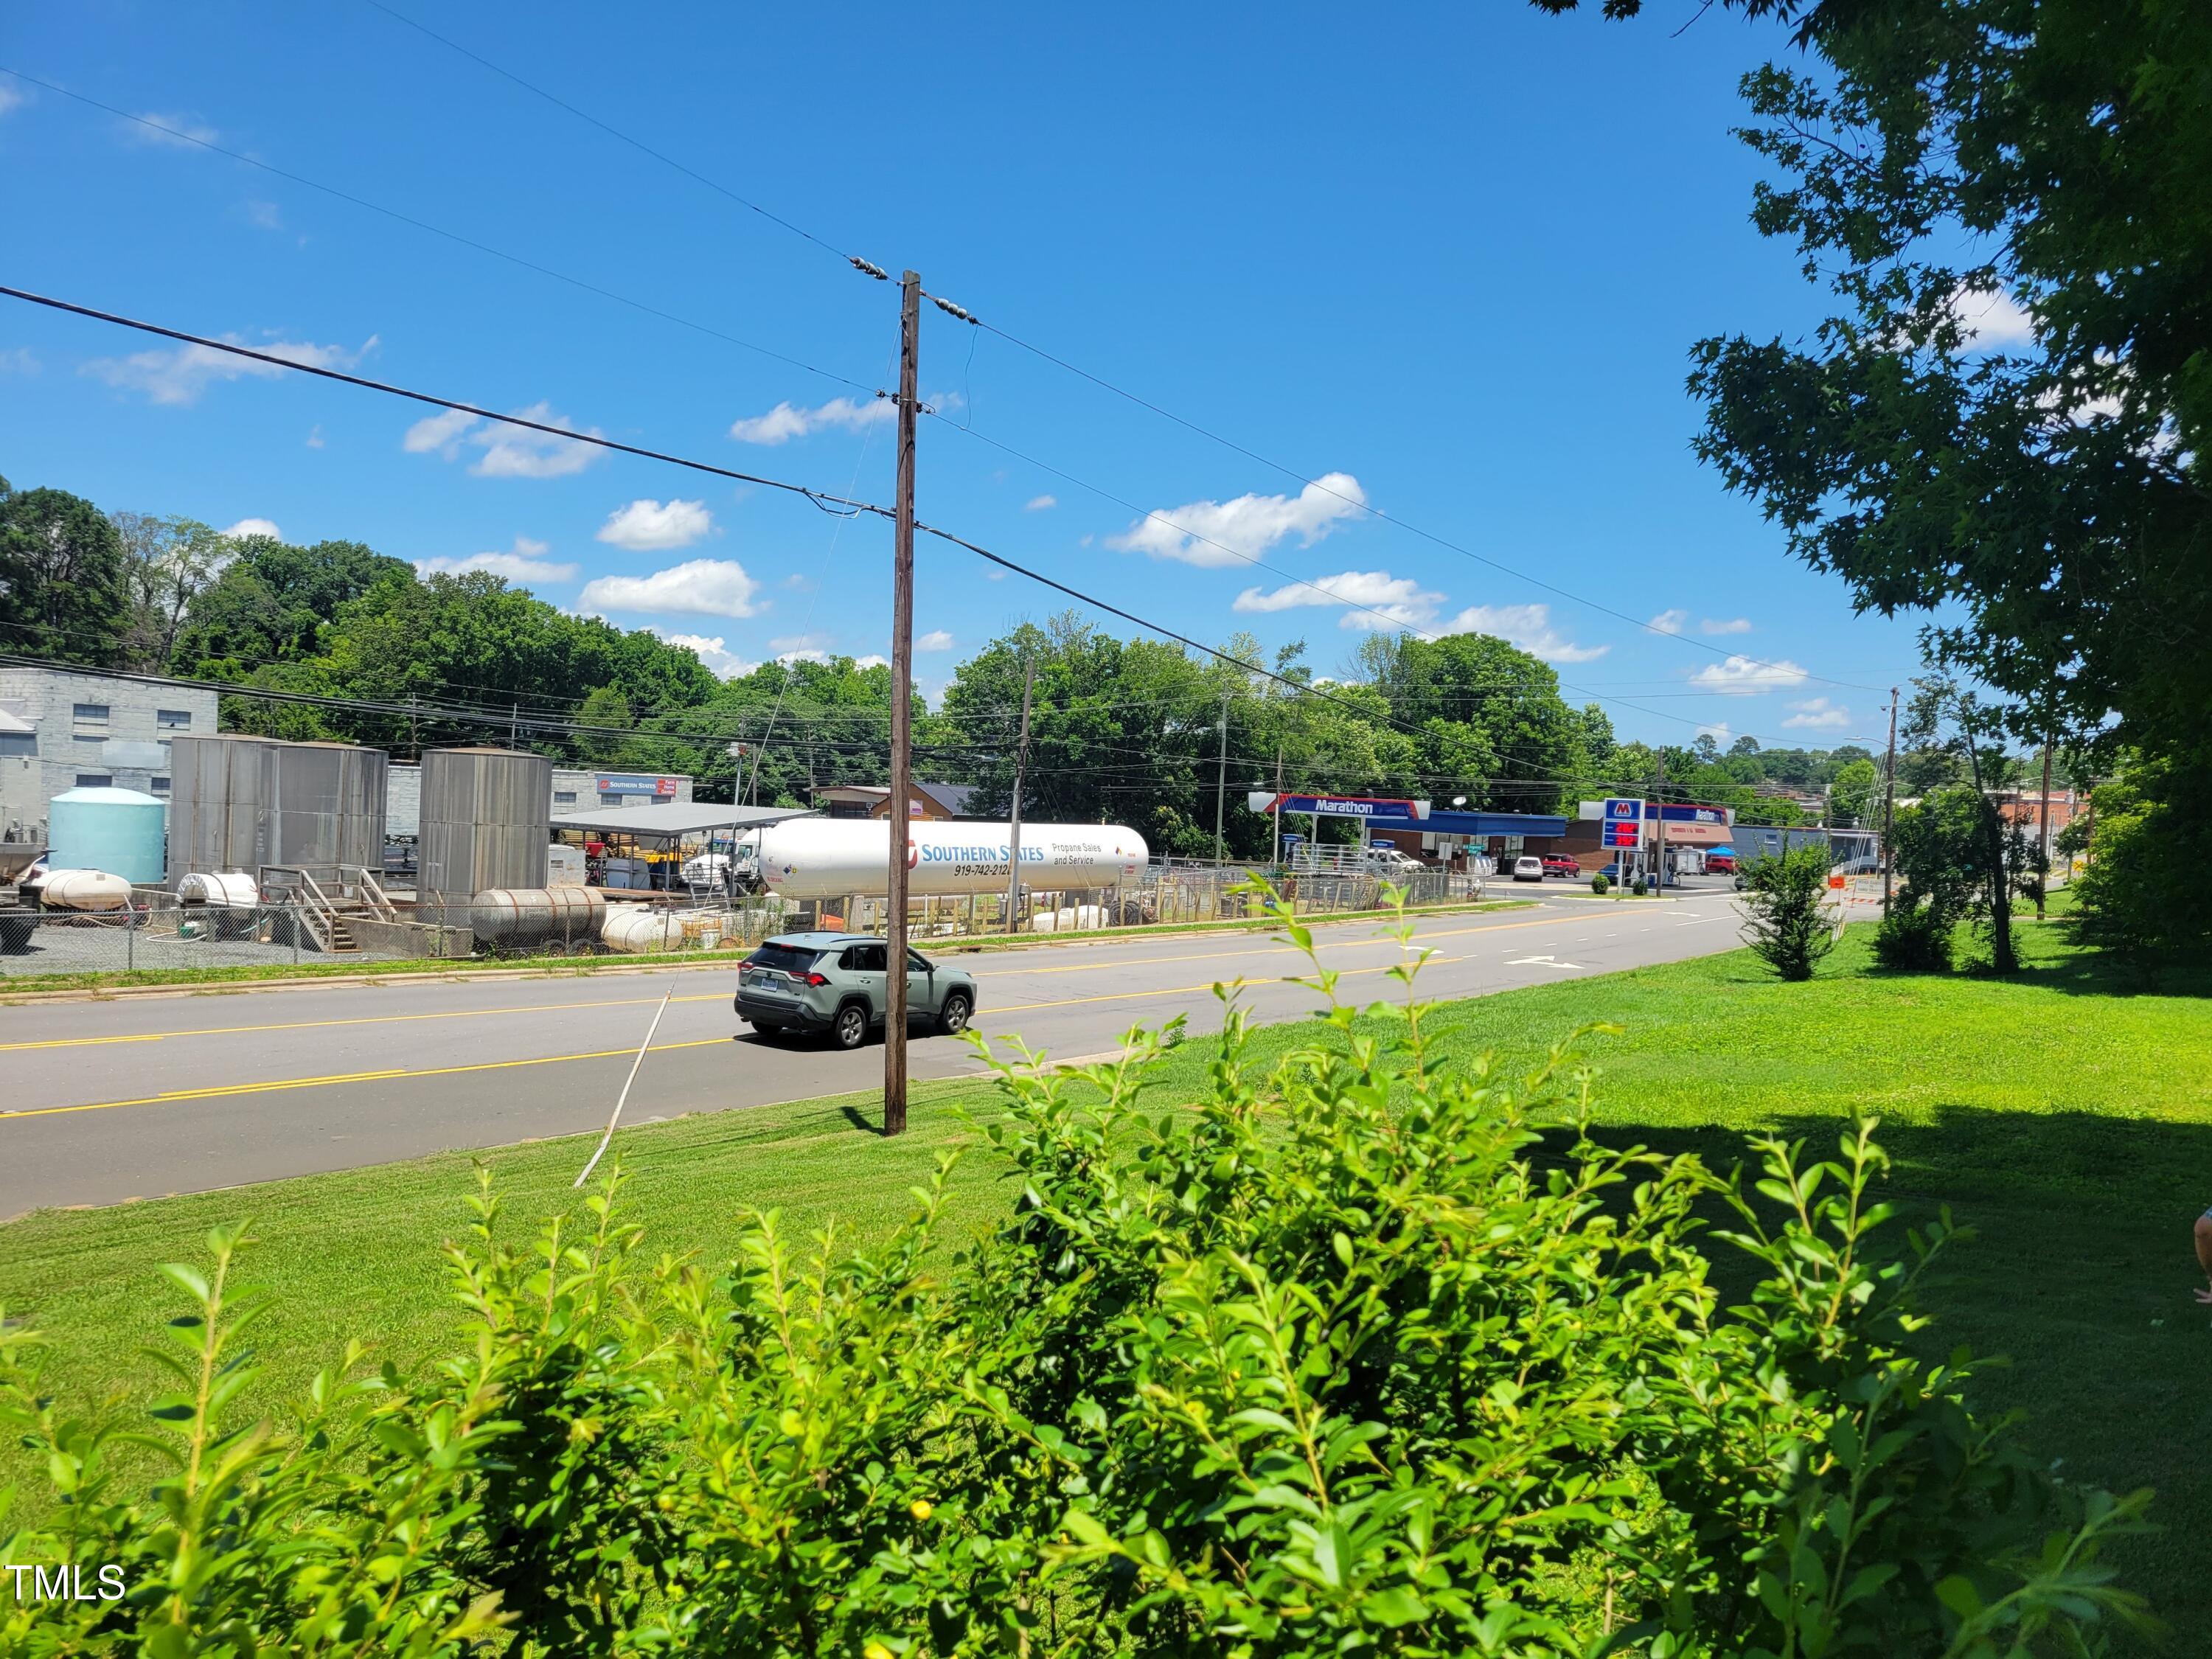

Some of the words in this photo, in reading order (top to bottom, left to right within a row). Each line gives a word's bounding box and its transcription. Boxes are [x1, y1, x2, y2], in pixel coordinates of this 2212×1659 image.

[1315, 800, 1373, 813] Marathon
[922, 844, 996, 861] SOUTHERN
[1000, 845, 1044, 861] SATES
[1052, 844, 1082, 854] Propane
[1082, 843, 1102, 852] Sales
[1054, 855, 1067, 866] and
[1068, 855, 1094, 865] Service
[954, 864, 1011, 876] 919-742-212
